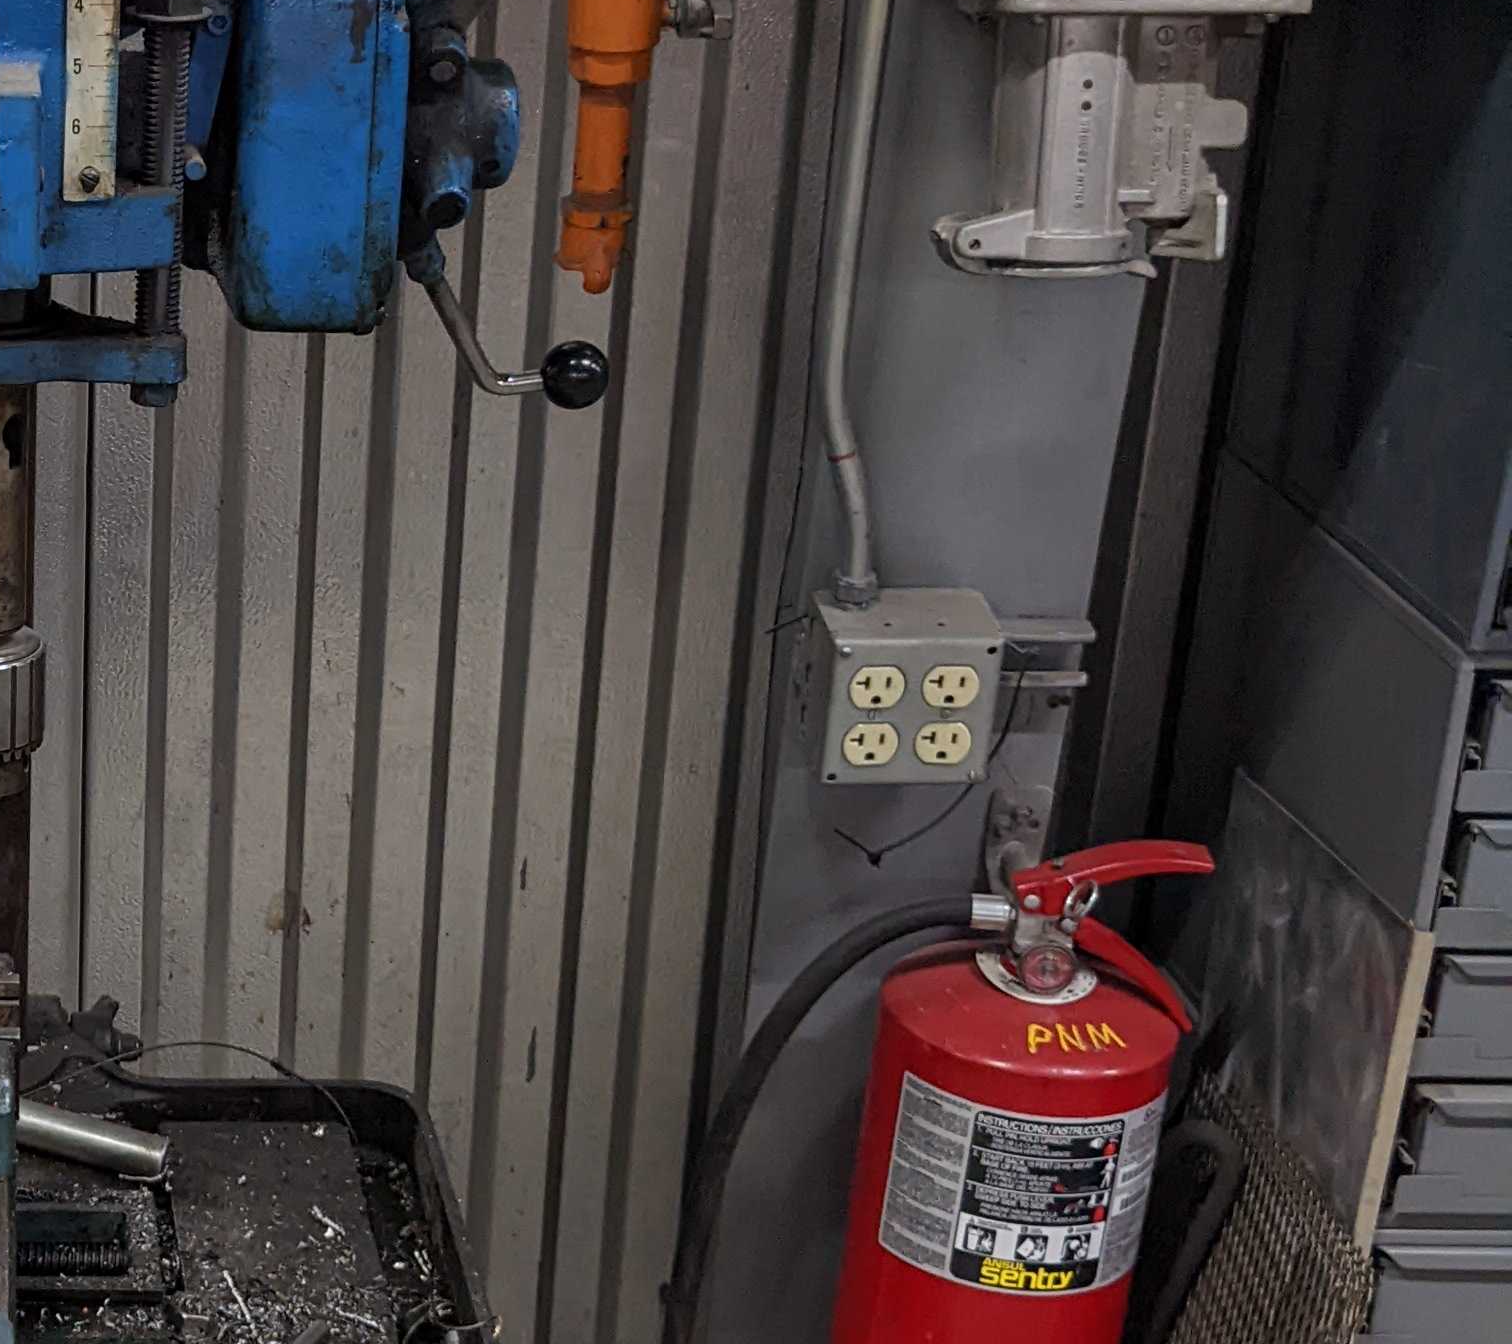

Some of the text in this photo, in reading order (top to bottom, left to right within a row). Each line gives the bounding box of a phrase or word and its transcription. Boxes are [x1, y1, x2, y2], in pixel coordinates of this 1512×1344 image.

[73, 59, 82, 75] 5
[71, 119, 81, 135] 6
[1026, 1023, 1129, 1055] PNM
[982, 1256, 1025, 1270] ANSUL
